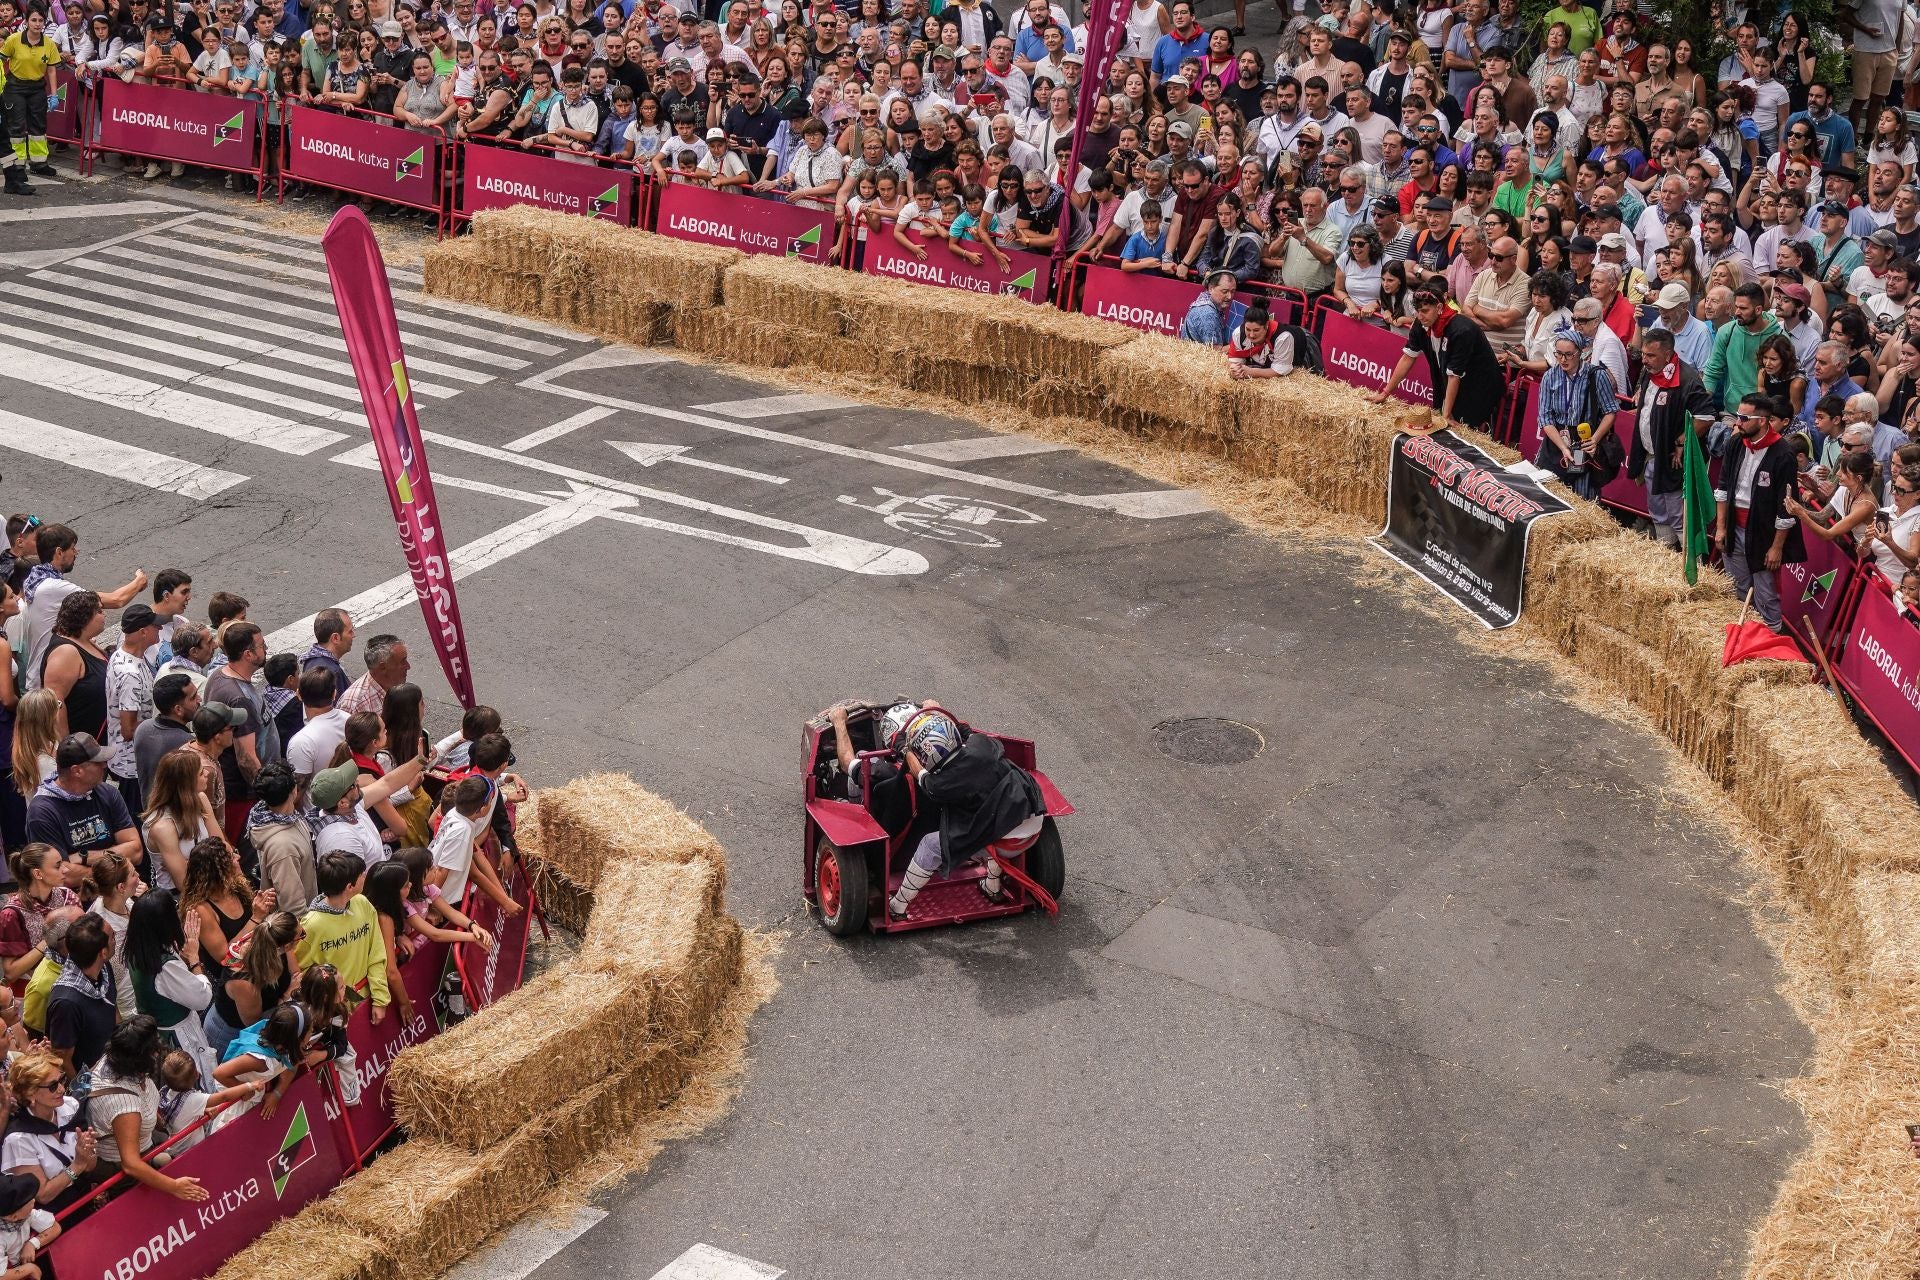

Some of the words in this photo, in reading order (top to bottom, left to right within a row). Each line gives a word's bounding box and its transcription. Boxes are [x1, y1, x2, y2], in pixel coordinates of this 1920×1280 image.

[112, 108, 170, 130] LABORAL
[173, 115, 207, 136] kutxa
[301, 136, 355, 162] LABORAL
[358, 149, 389, 169] kutxa
[476, 175, 540, 201] LABORAL
[543, 185, 580, 208] kutxa
[669, 213, 736, 241] LABORAL
[739, 226, 778, 249] kutxa
[876, 255, 946, 284] LABORAL
[950, 271, 991, 293] kutxa
[1097, 300, 1174, 330] LABORAL
[1464, 500, 1472, 514] DE
[1858, 628, 1901, 688] LABORAL
[320, 932, 348, 951] DEMON
[197, 1177, 259, 1230] kutxa
